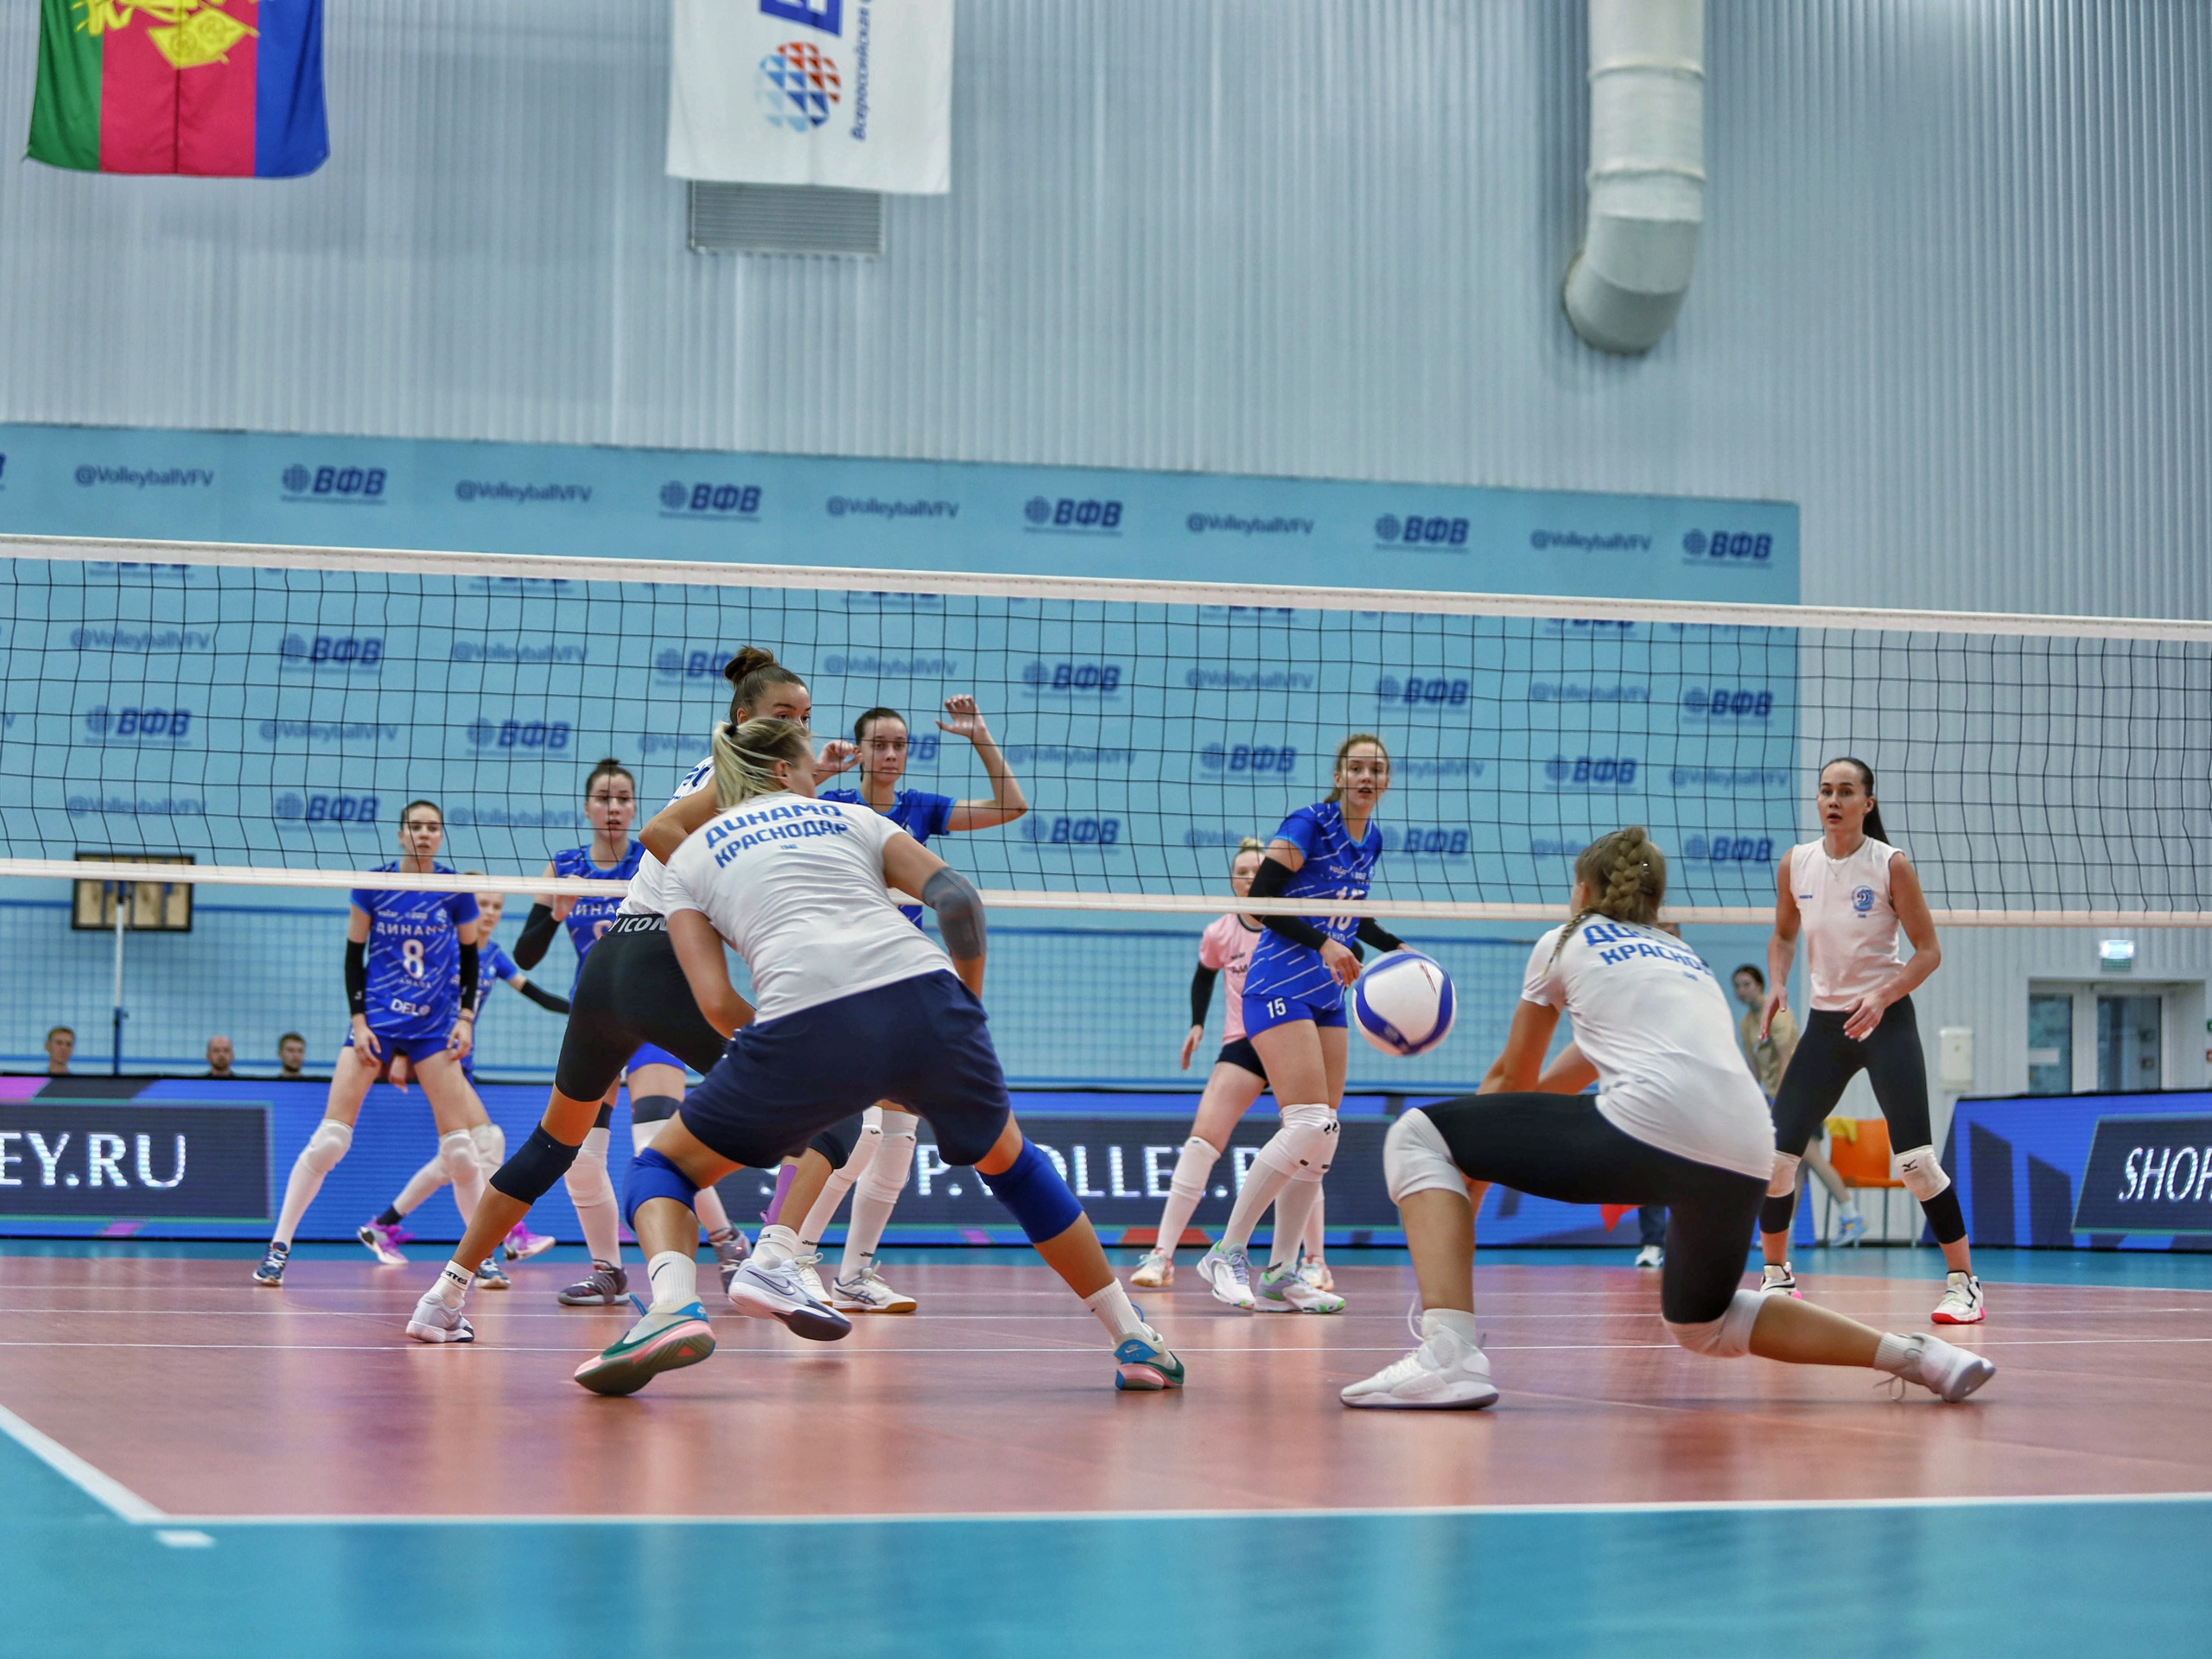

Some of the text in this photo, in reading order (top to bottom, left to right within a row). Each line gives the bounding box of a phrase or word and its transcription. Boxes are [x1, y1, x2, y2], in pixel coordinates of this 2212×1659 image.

[312, 466, 387, 496] ВФВ
[690, 482, 762, 512] ВФВ
[1052, 499, 1123, 528] ВФВ
[1402, 517, 1469, 545] ВФВ
[1710, 530, 1773, 560] ВФВ
[308, 637, 382, 666] ВФВ
[1052, 664, 1122, 692] ВФВ
[1402, 678, 1469, 706] ВФВ
[1709, 690, 1774, 718] ВФВ
[116, 708, 192, 738] ВФВ
[497, 721, 572, 749] ВФВ
[1229, 745, 1296, 774] ВФВ
[1572, 757, 1637, 784] ВФВ
[305, 795, 381, 823] ВФВ
[714, 819, 849, 869] КРАСНОДАР
[1050, 817, 1122, 844] ВФВ
[1402, 827, 1470, 855] ВФВ
[1709, 836, 1774, 864] ВФВ
[402, 939, 424, 980] 8
[1266, 996, 1287, 1019] 15
